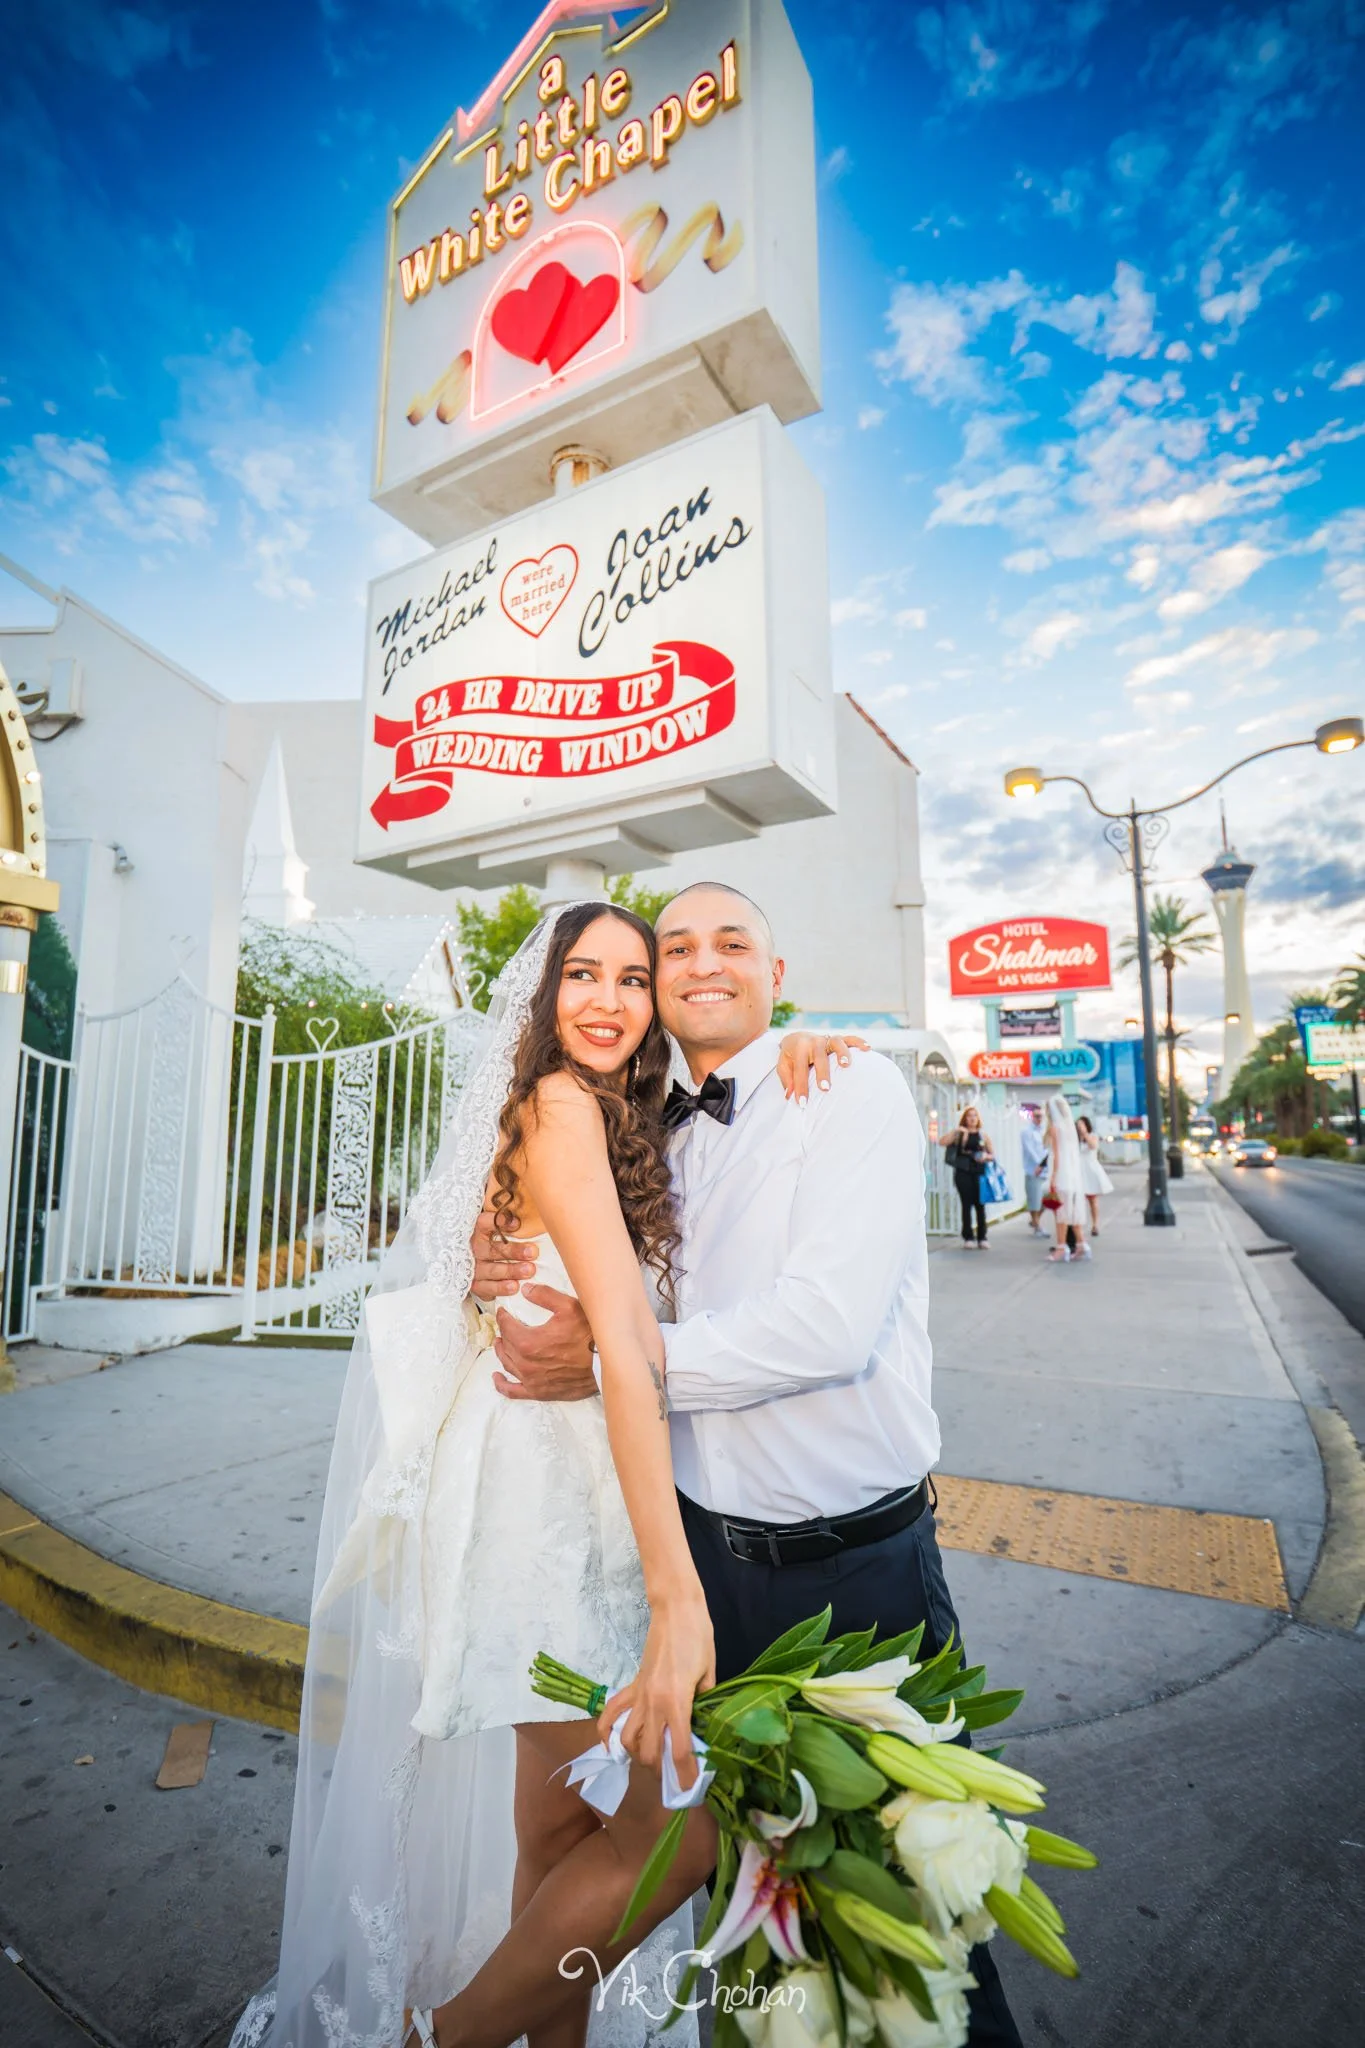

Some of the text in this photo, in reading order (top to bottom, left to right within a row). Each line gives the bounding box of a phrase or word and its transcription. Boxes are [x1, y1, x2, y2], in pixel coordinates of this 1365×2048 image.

[538, 54, 566, 101] a
[483, 67, 630, 198] Little
[399, 39, 741, 304] White Chapel
[607, 486, 713, 600] Joan
[376, 537, 497, 648] Michael
[511, 573, 565, 607] married
[522, 565, 553, 585] were
[578, 516, 753, 658] Collins
[522, 600, 552, 620] here
[382, 596, 486, 696] Jordan
[421, 672, 664, 724] 24 HR DRIVE UP
[411, 701, 710, 773] WEDDING WINDOW
[1003, 922, 1048, 937] HOTEL
[959, 933, 1098, 977] Shalimar
[998, 971, 1059, 986] LAS VEGAS
[977, 1065, 1024, 1077] HOTEL
[1035, 1050, 1088, 1068] AQUA
